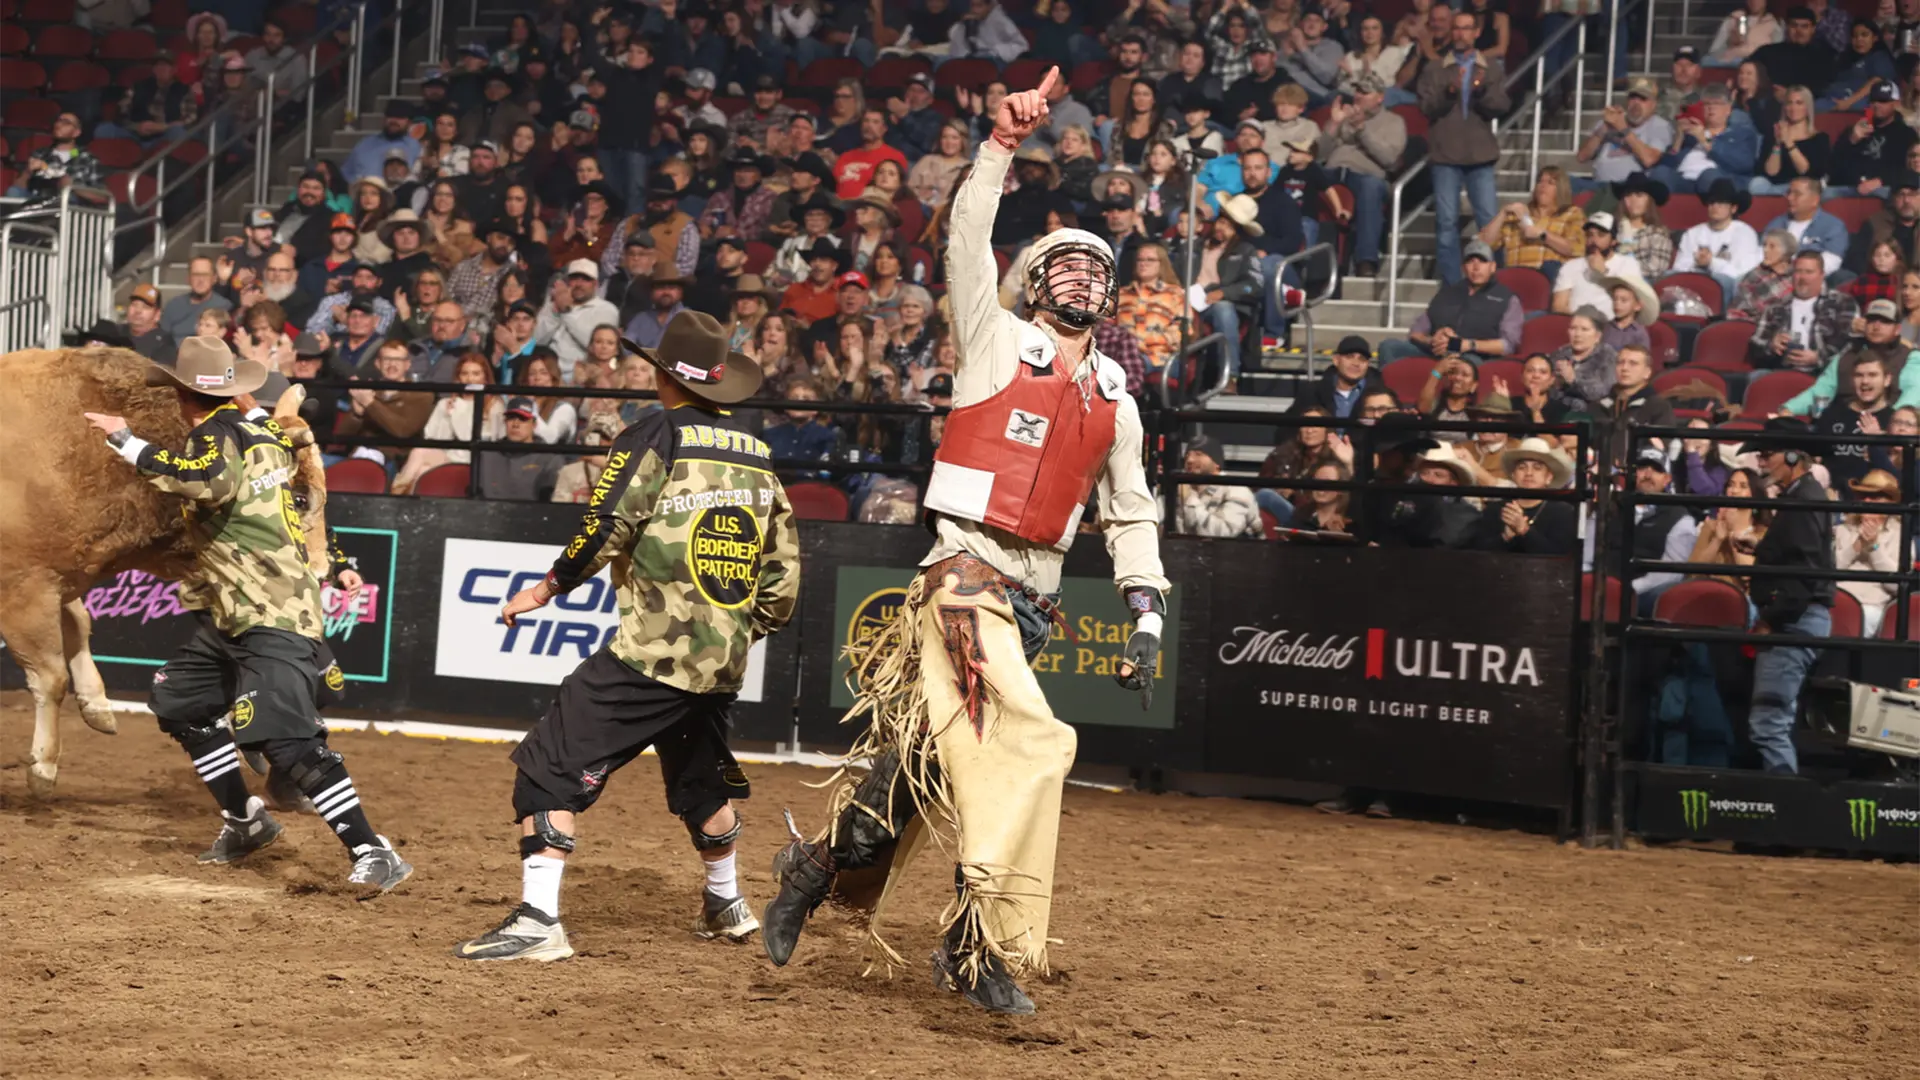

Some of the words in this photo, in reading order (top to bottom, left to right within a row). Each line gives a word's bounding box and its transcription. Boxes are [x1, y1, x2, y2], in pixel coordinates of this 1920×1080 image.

[679, 424, 772, 460] AUSTIN
[661, 488, 753, 515] PROTECTED
[714, 515, 742, 534] U.S.
[697, 537, 759, 561] BORDER
[698, 558, 755, 581] PATROL
[1077, 615, 1137, 644] Stat
[1219, 625, 1360, 670] Michelob
[1395, 637, 1540, 687] ULTRA
[1260, 689, 1357, 713] SUPERIOR
[1368, 699, 1427, 719] LIGHT
[1438, 706, 1490, 725] BEER
[1709, 799, 1776, 814] MONSTER
